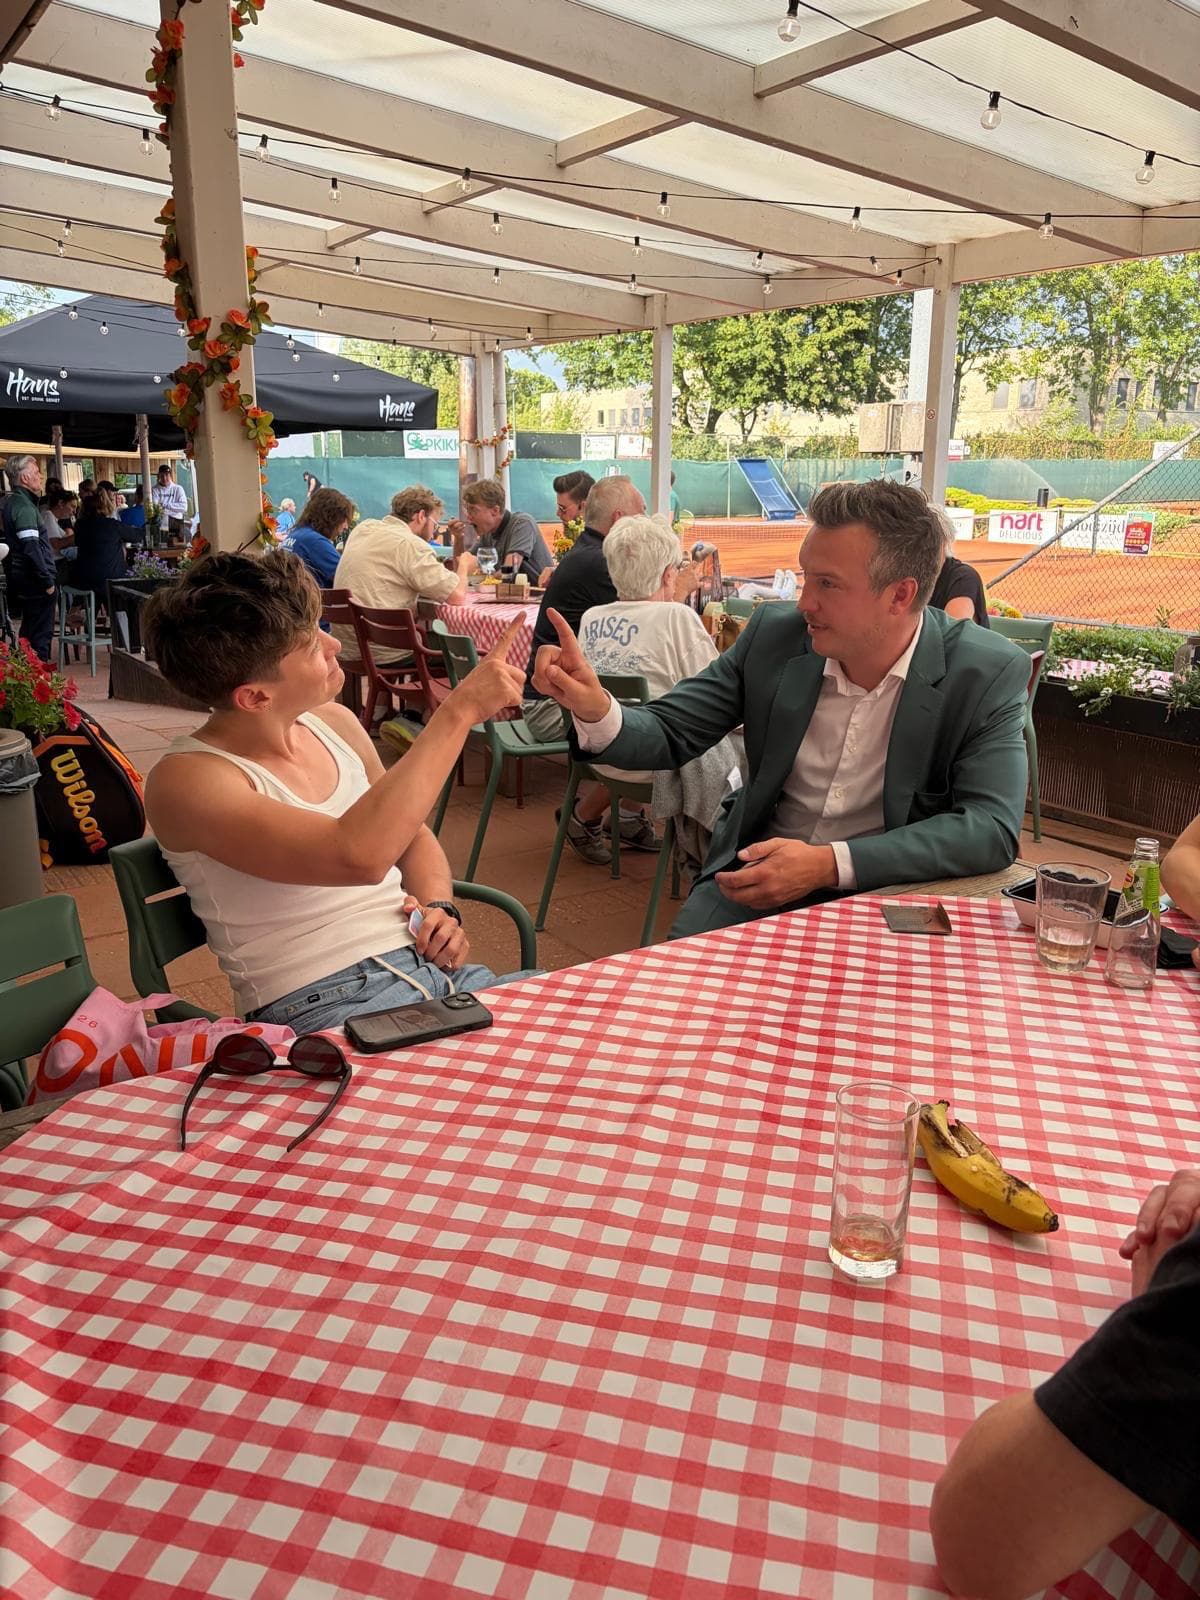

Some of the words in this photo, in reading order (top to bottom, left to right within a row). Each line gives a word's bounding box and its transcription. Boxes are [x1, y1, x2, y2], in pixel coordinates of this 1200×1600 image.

[6, 367, 60, 403] Hans
[379, 394, 416, 423] Hans
[1000, 512, 1043, 531] nart
[1000, 530, 1042, 541] DELICIOUS
[50, 748, 108, 854] Wilson
